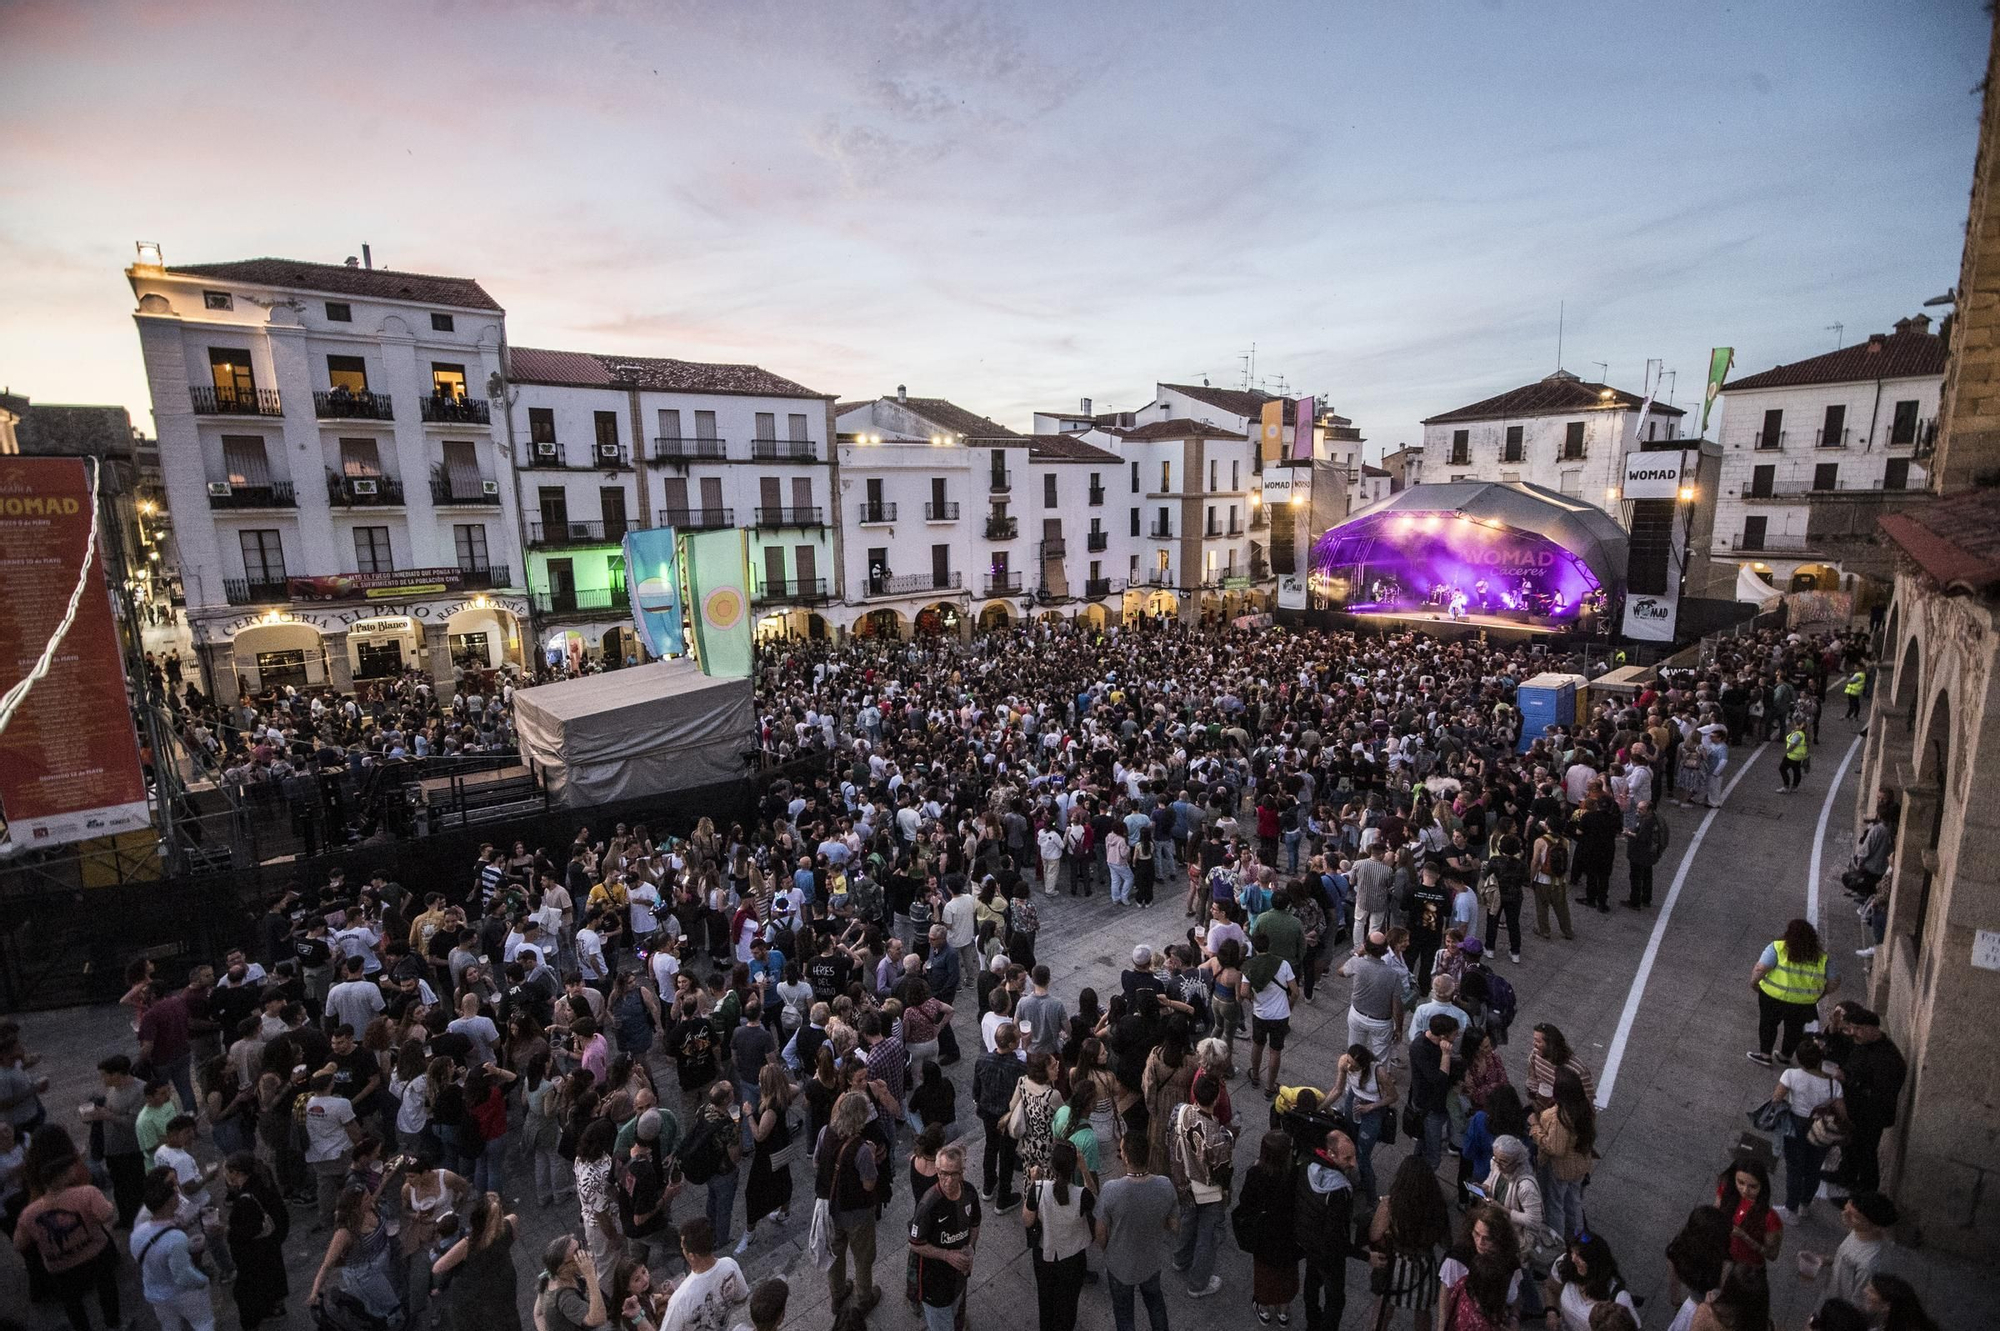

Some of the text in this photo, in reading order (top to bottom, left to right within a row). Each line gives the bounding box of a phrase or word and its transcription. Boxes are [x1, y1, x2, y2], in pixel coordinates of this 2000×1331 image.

[1629, 469, 1676, 481] WOMAD
[1264, 481, 1290, 489] WOMAD
[1464, 550, 1554, 566] WOMAD
[392, 571, 420, 579] INMEDIATO
[1489, 565, 1547, 577] Cáceres
[360, 580, 399, 588] SUFRIMIENTO
[356, 623, 376, 633] Pato
[378, 621, 408, 632] Blanco
